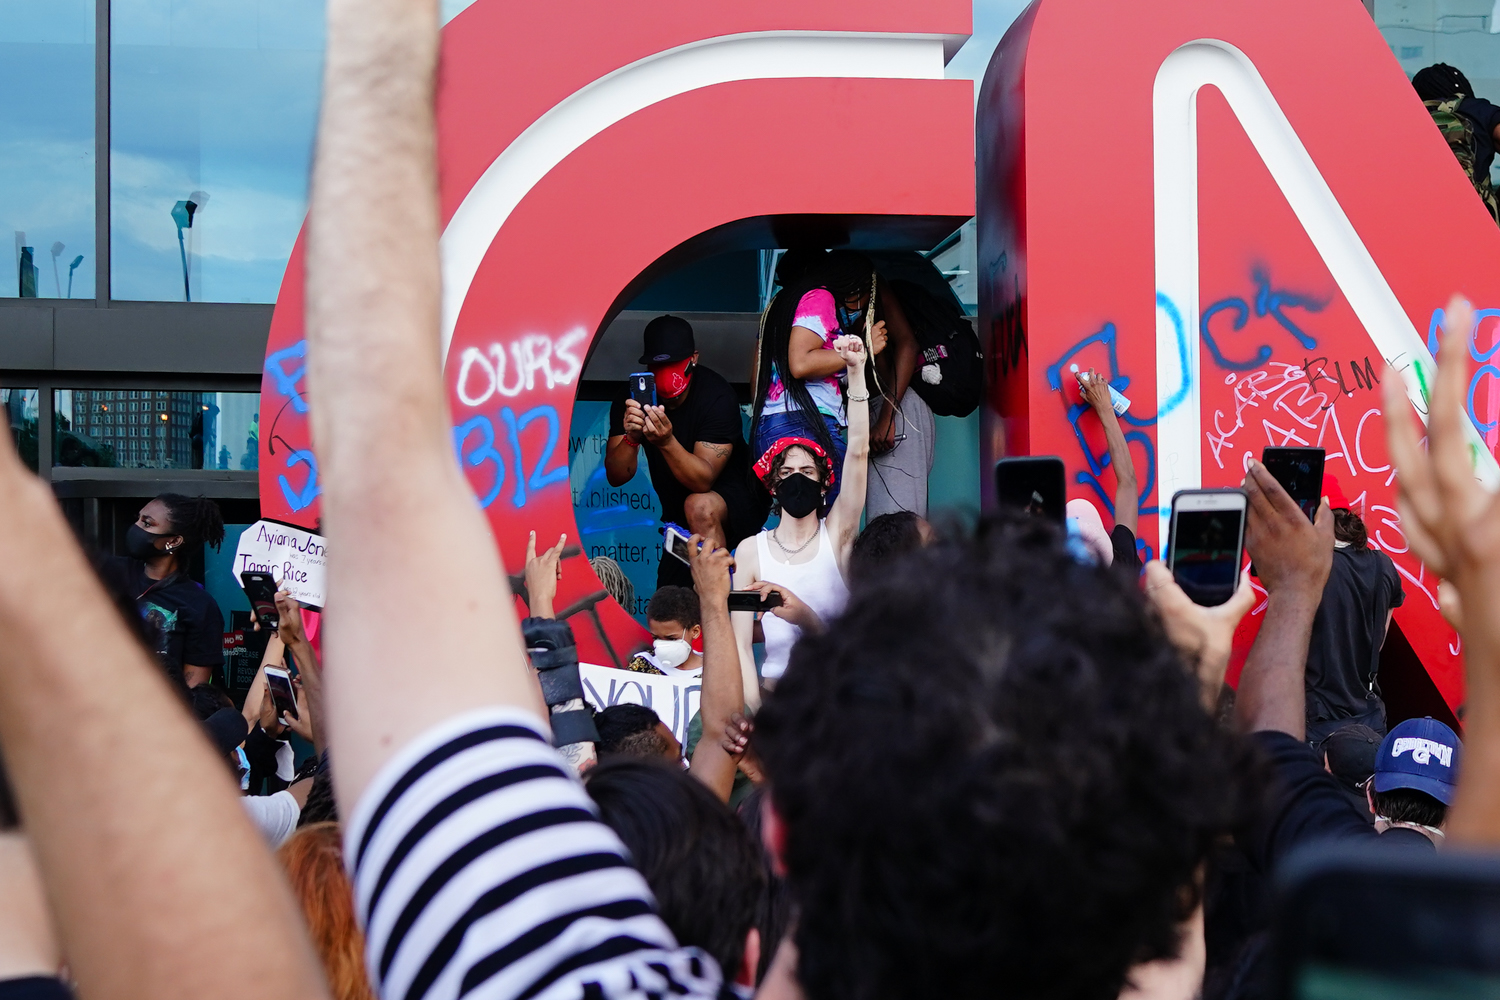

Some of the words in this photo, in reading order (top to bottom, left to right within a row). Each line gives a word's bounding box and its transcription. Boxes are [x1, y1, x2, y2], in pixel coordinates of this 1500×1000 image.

[457, 326, 588, 407] OURS
[572, 487, 656, 513] tablished,
[298, 535, 329, 558] Jone
[591, 540, 650, 565] matter,
[283, 561, 308, 583] Rice
